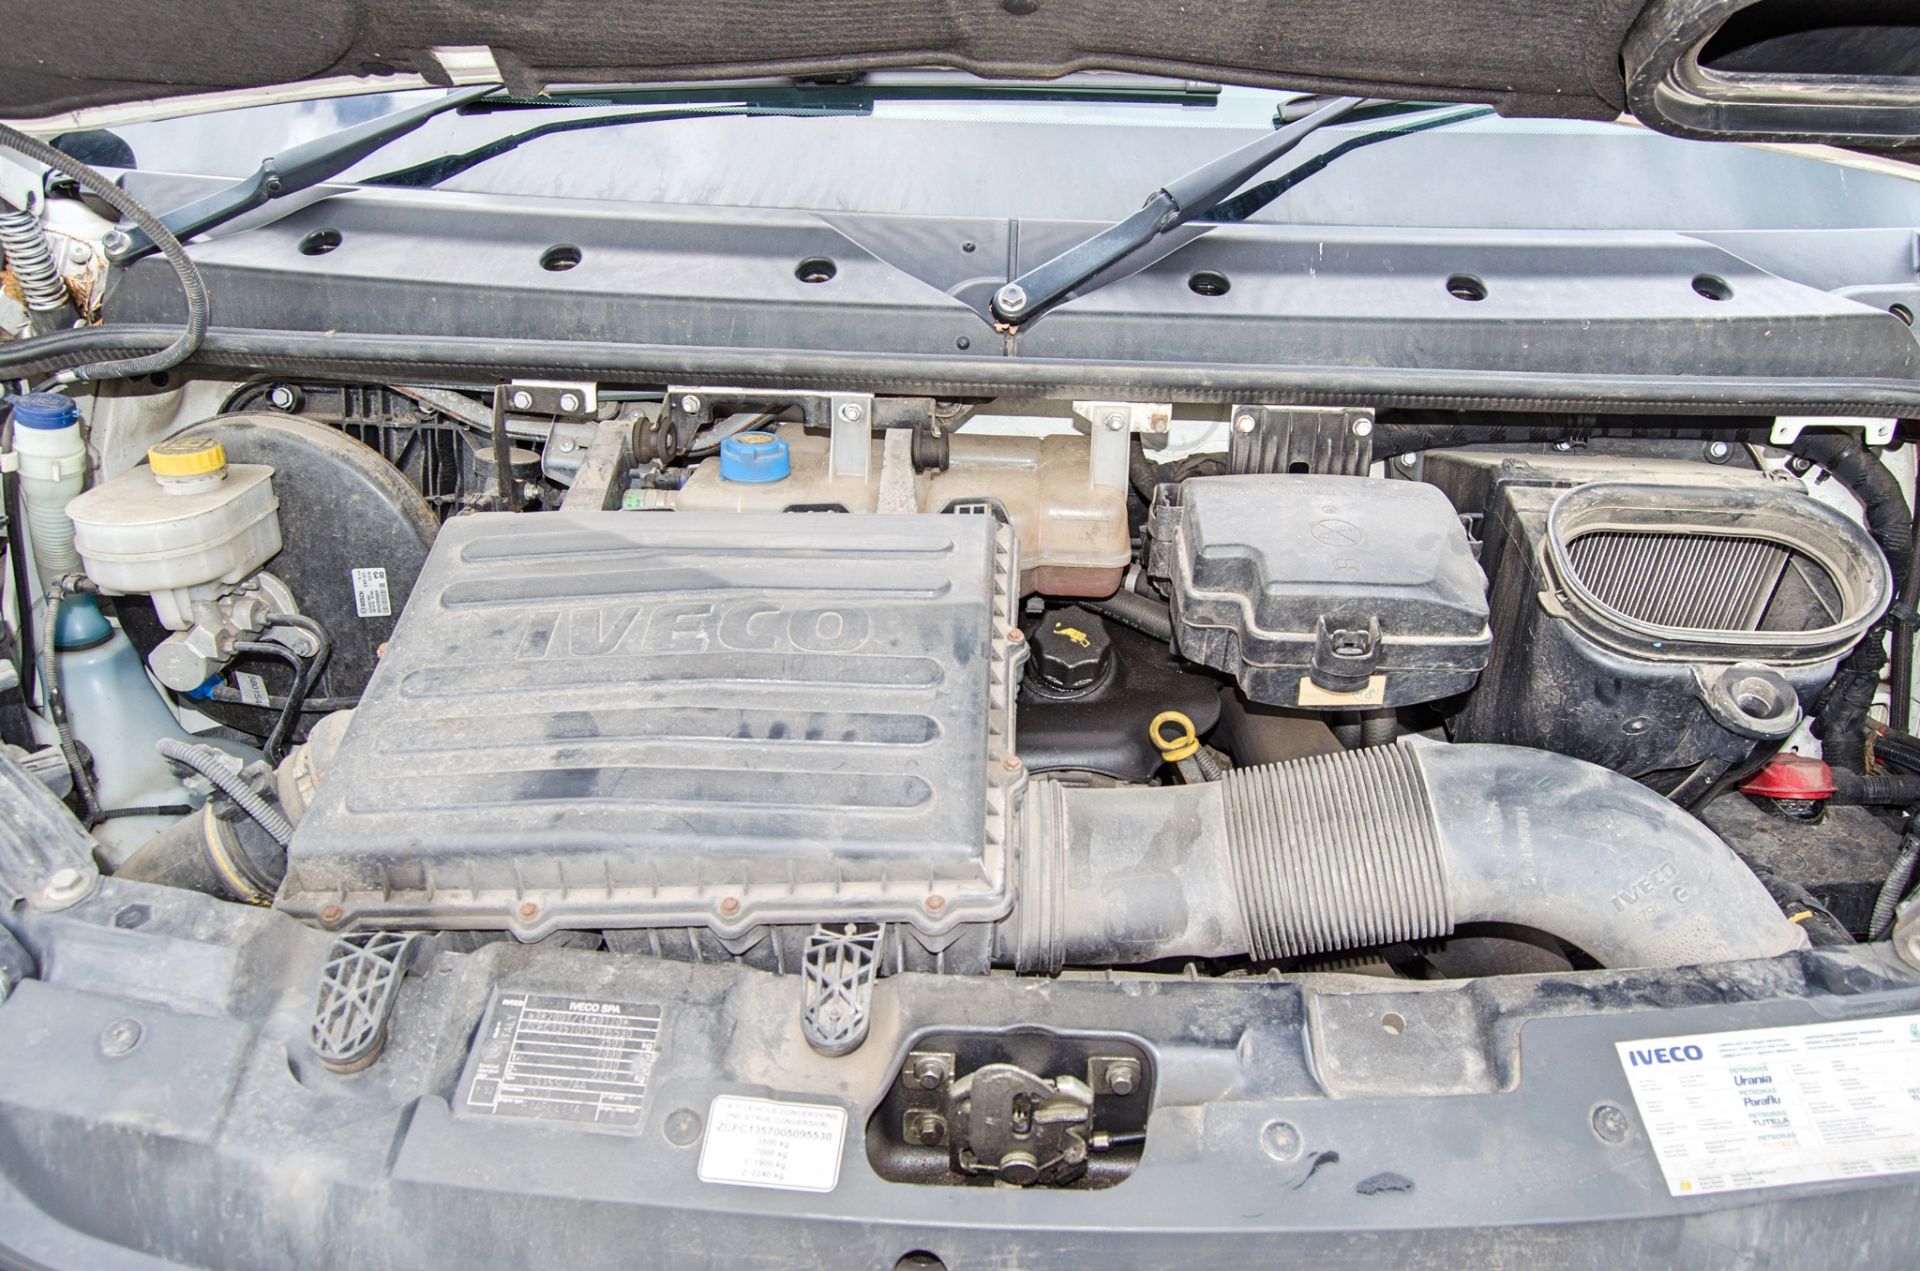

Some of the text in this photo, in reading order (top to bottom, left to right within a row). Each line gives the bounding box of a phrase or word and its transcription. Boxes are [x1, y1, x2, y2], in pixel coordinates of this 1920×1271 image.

[515, 601, 871, 660] IVECO
[1612, 862, 1677, 913] IVECO
[569, 1002, 621, 1014] IVECO SPA
[1629, 1045, 1704, 1067] IVECO
[1734, 1075, 1773, 1086] Urania
[1743, 1095, 1781, 1107] Paraflu
[780, 1107, 838, 1119] CONVERSIONS
[774, 1117, 828, 1128] CONVERSION
[1752, 1117, 1790, 1126] TUTELA
[716, 1121, 833, 1142] ZCFC1357005095530
